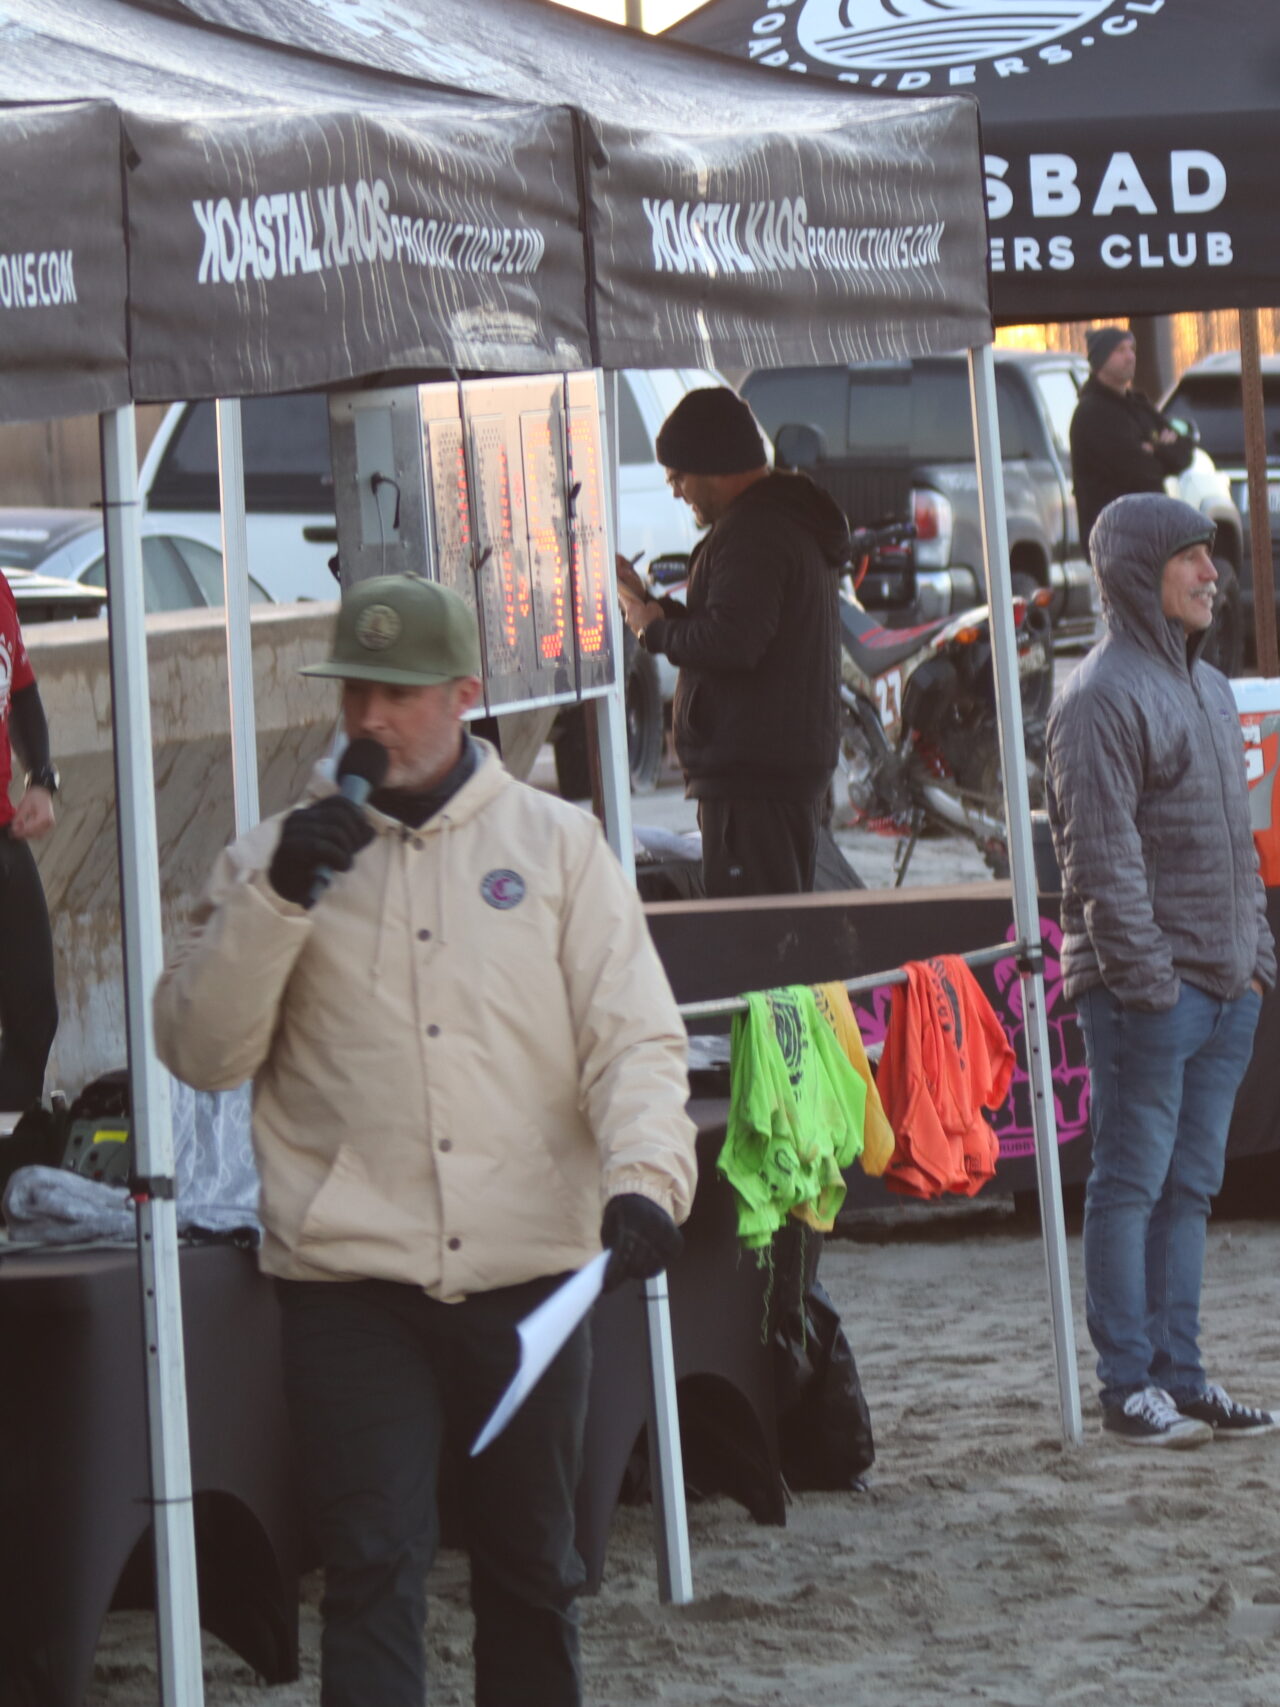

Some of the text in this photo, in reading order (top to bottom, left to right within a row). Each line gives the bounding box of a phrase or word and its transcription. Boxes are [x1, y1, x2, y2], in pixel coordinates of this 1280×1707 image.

[984, 149, 1227, 220] SBAD
[192, 194, 322, 284] KOASTAL
[317, 178, 394, 270] KAOS
[642, 196, 756, 276] KOASTAL
[744, 195, 810, 272] KAOS
[990, 231, 1234, 272] ERS CLUB
